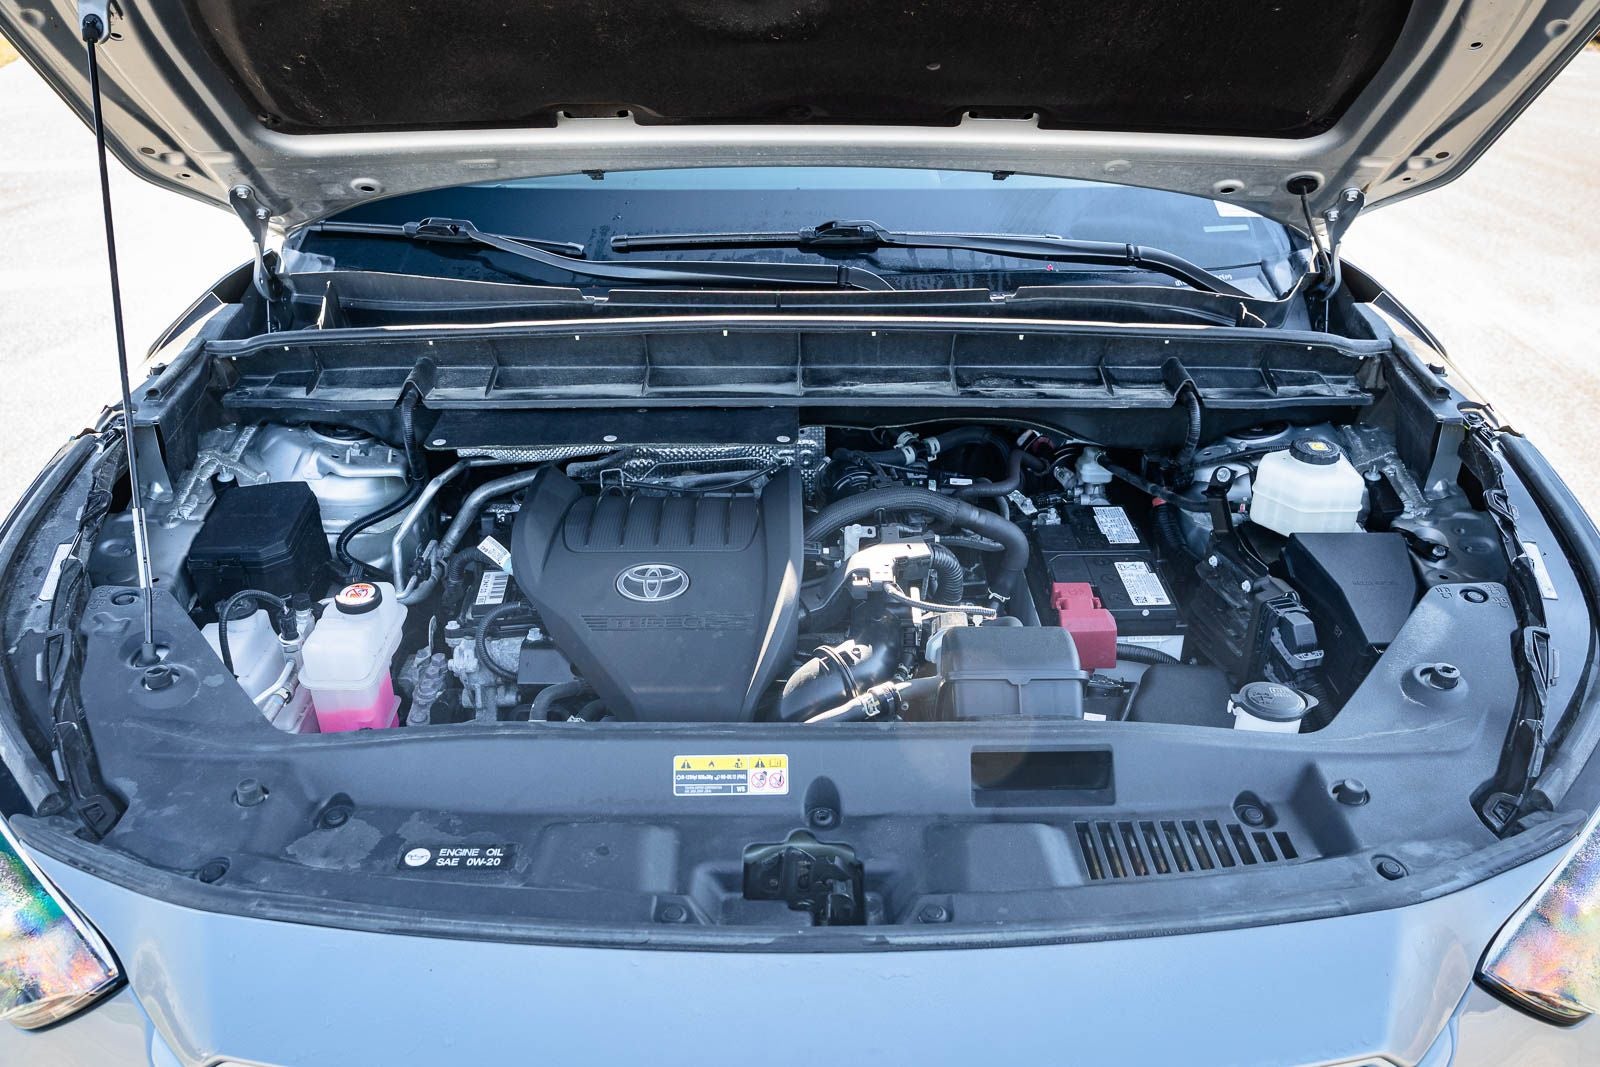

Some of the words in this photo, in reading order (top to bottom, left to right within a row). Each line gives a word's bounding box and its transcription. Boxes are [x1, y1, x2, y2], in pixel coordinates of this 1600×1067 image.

[439, 848, 480, 856] ENGINE
[486, 848, 504, 856] OIL
[436, 858, 460, 866] SAE
[466, 858, 501, 866] 0W-20
